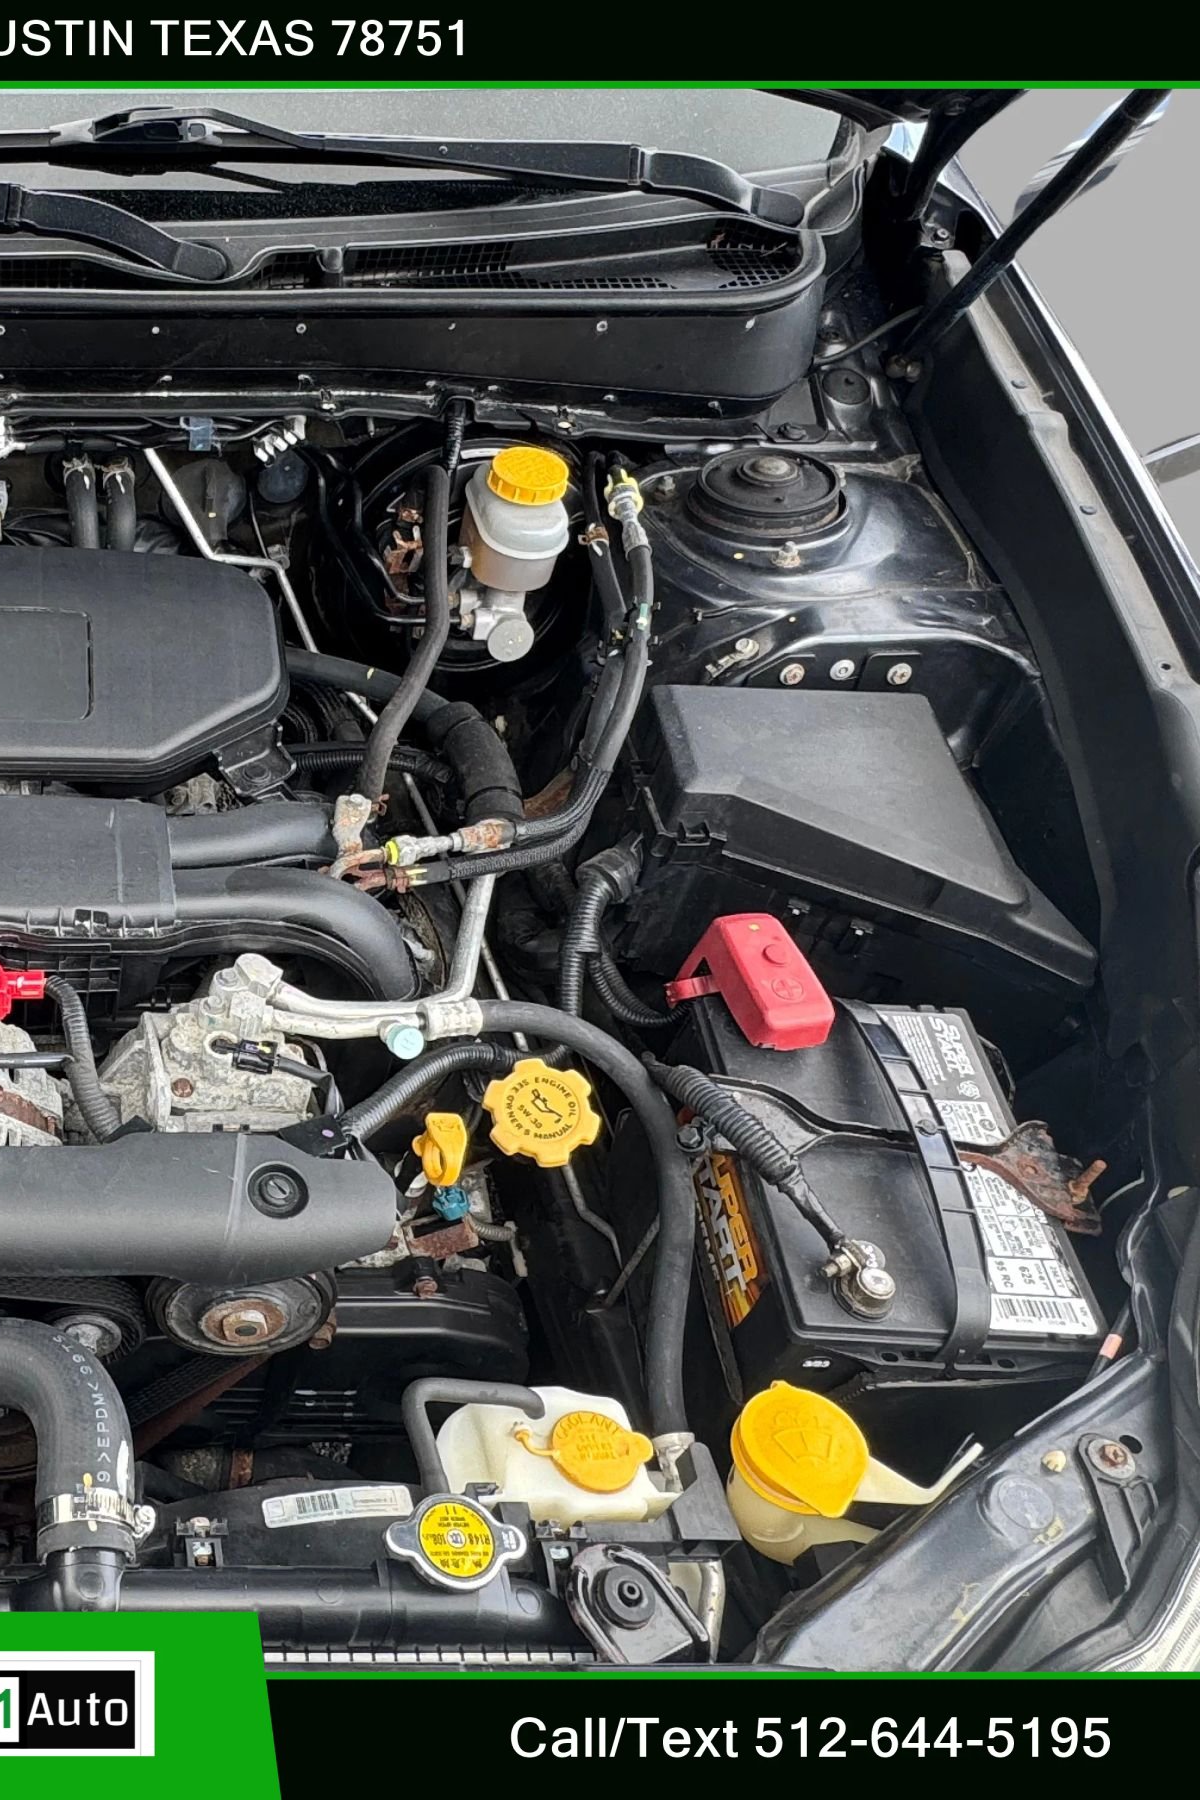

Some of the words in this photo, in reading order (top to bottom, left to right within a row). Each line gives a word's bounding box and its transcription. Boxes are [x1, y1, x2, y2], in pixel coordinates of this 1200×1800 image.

[533, 1123, 573, 1140] MANUAL
[535, 1076, 573, 1099] ENGINE
[568, 1101, 577, 1118] OIL
[698, 1154, 748, 1292] TART
[711, 1153, 759, 1283] UPER
